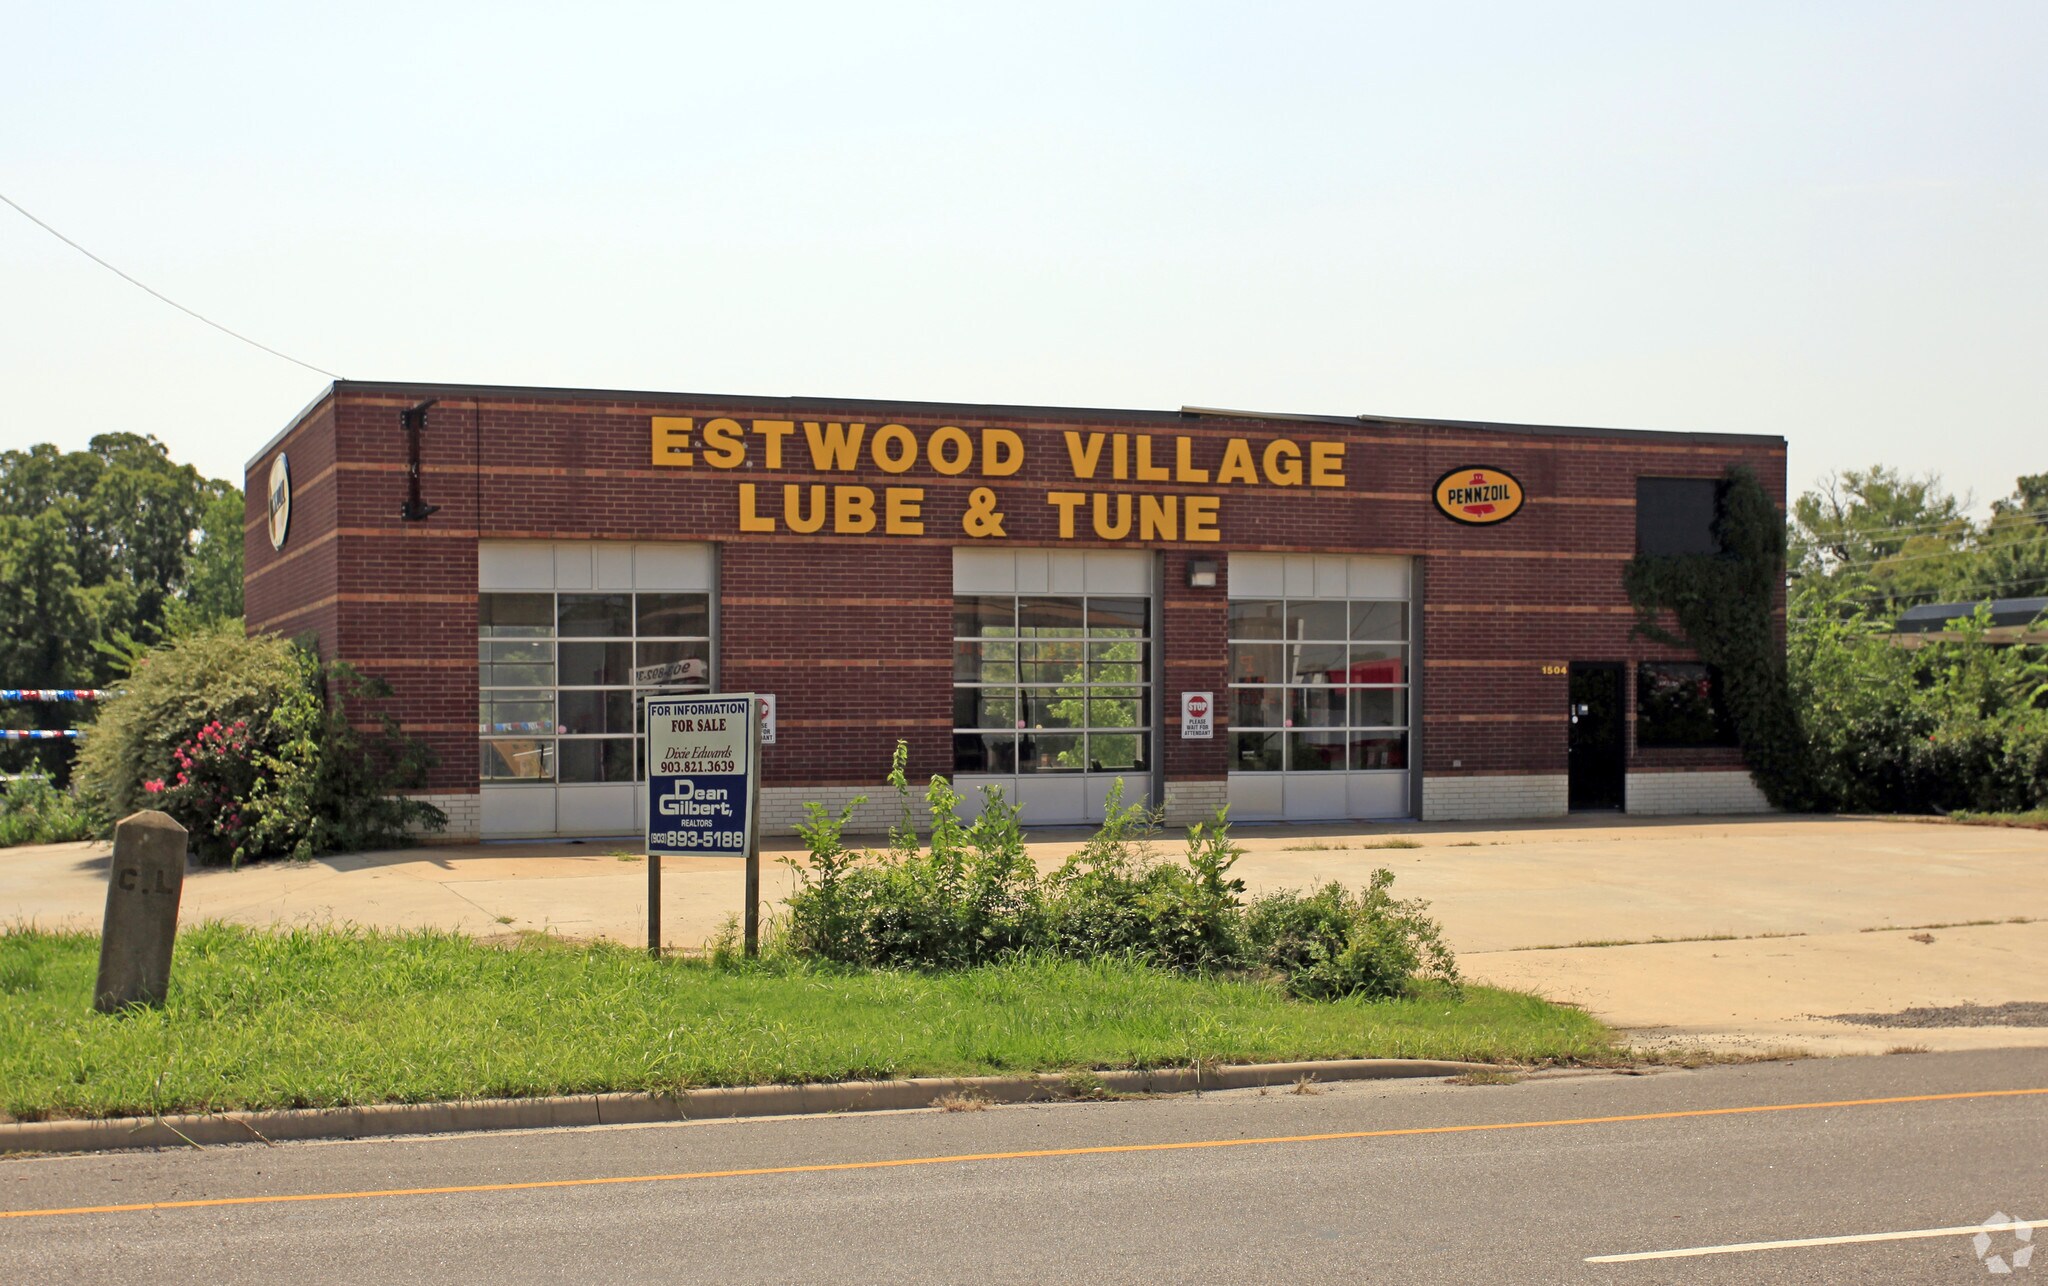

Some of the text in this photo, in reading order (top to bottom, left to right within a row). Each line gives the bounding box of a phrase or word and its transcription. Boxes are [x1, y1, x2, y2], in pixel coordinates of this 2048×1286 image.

[651, 416, 1346, 487] ESTWOOD VILLAGE
[1447, 484, 1511, 506] PENNZOIL
[738, 483, 1221, 542] LUBE & TUNE
[1542, 665, 1568, 675] 1504
[651, 703, 745, 716] FOR INFORMATION
[1188, 701, 1207, 711] STOP
[671, 718, 727, 732] FOR SALE
[665, 744, 733, 760] Dixie Edwards
[660, 760, 735, 773] 903.821.3639
[674, 779, 728, 800] Dean
[659, 794, 733, 817] Gilbert,
[681, 819, 713, 827] REALTORS
